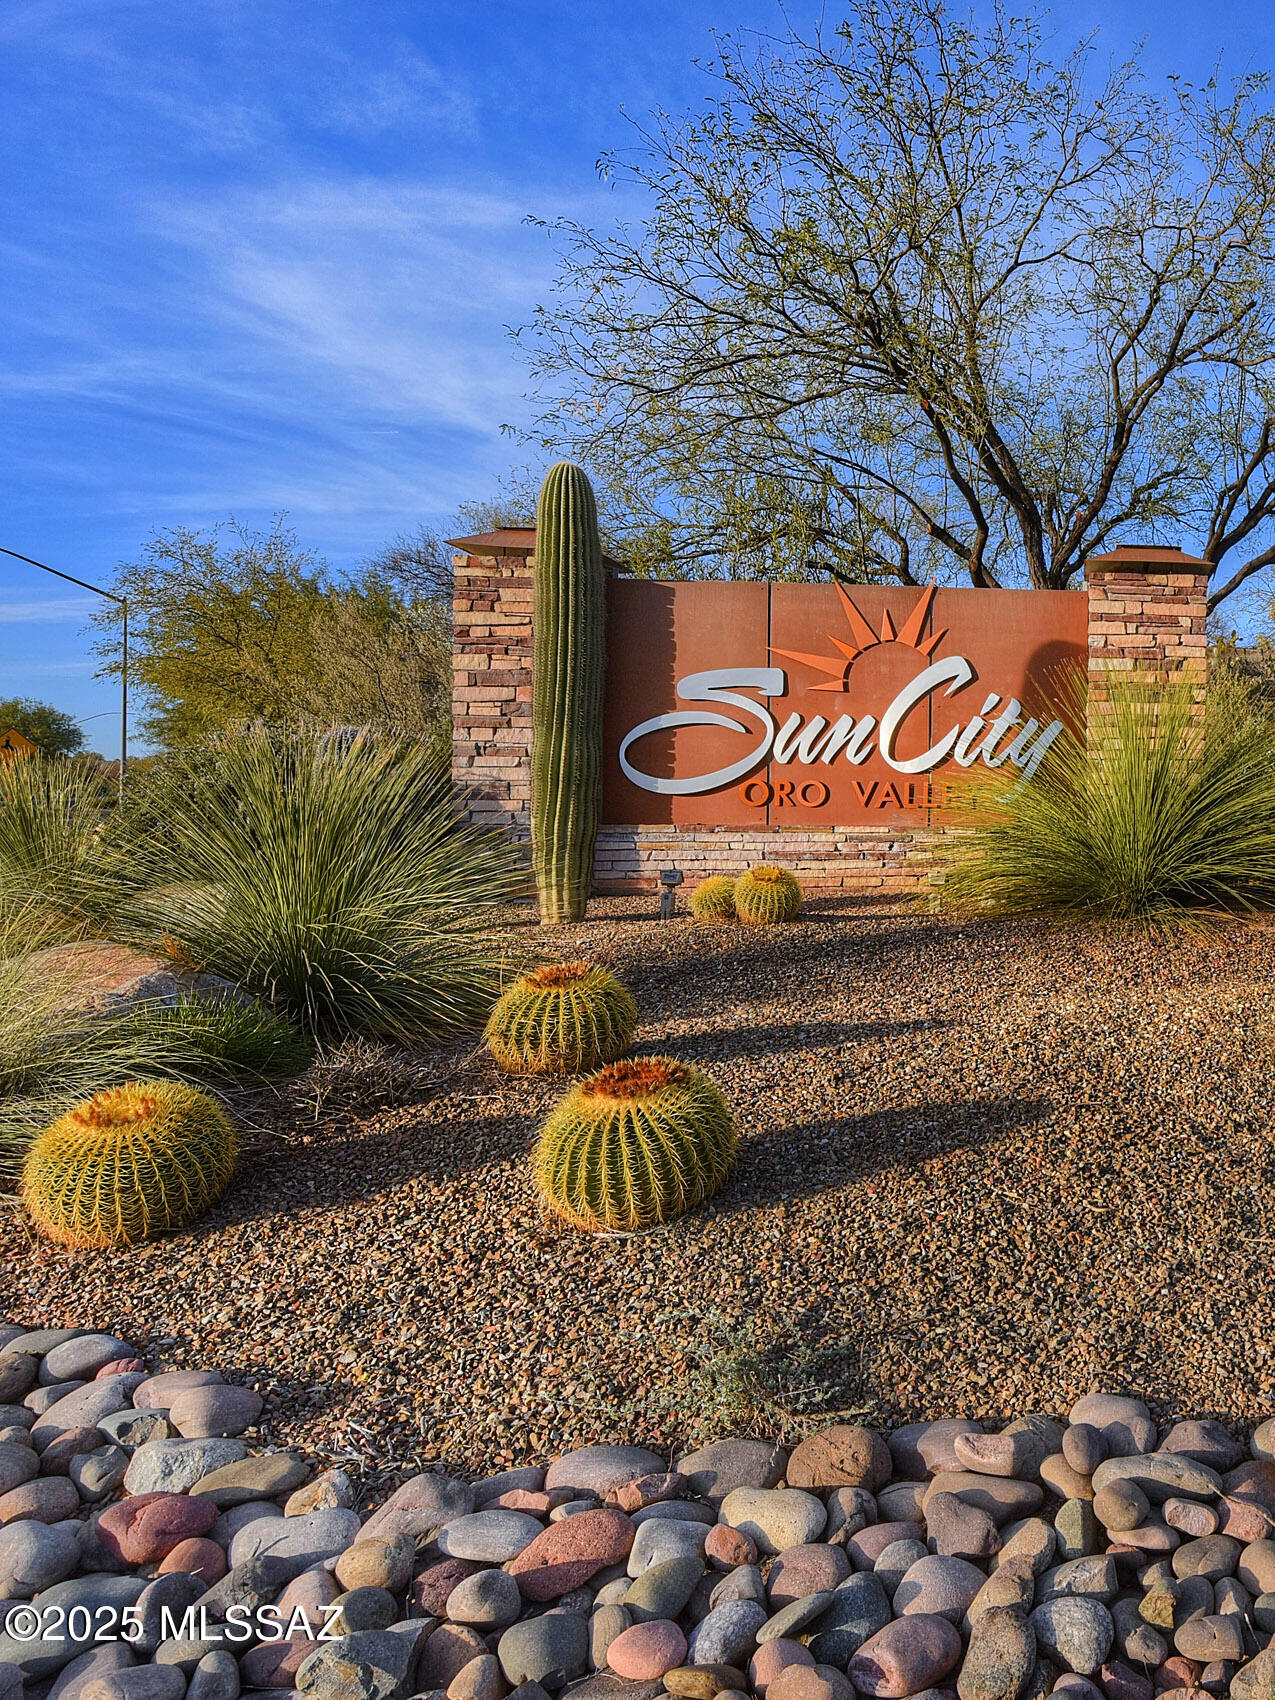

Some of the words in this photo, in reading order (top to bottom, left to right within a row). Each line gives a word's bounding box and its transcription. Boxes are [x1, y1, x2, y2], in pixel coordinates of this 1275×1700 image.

[619, 668, 876, 795] Sun
[879, 655, 1065, 803] City
[738, 780, 829, 808] ORO
